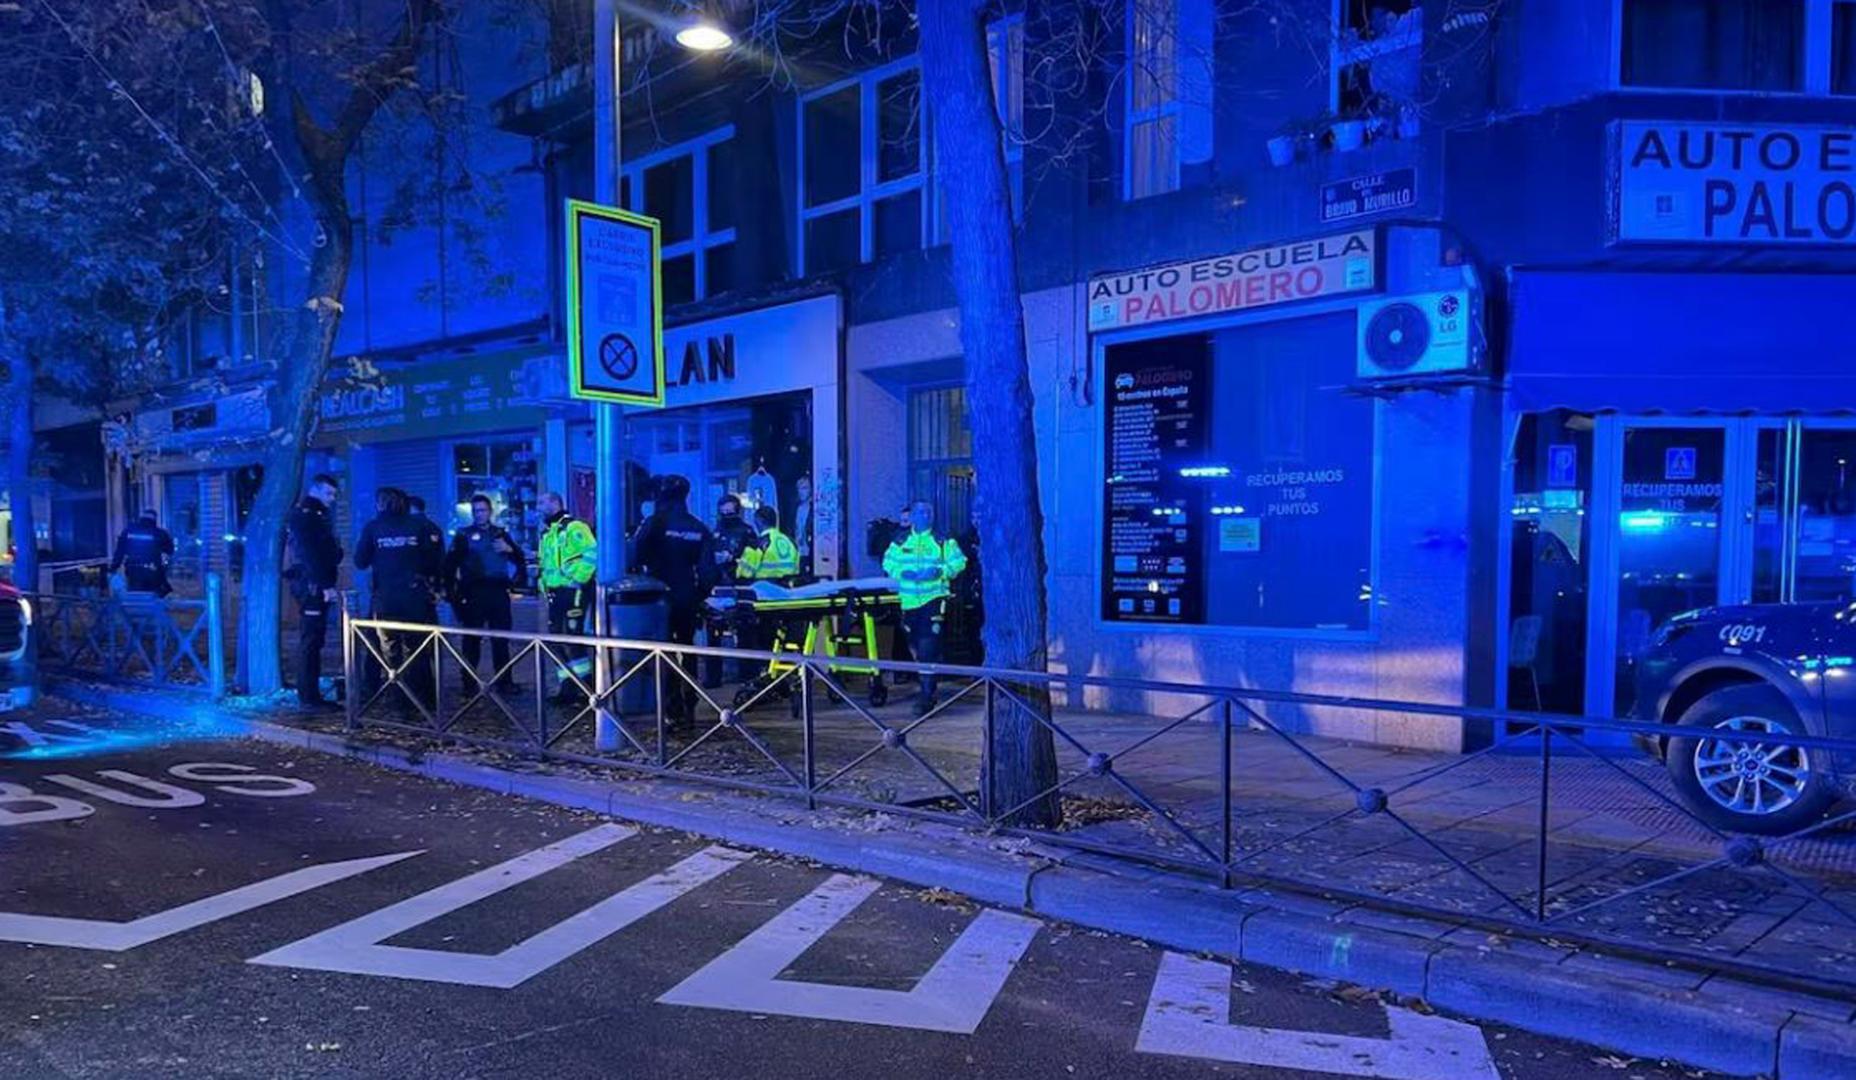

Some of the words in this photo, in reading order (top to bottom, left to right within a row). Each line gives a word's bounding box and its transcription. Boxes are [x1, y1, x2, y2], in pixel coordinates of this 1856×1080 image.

[1631, 129, 1801, 170] AUTO
[1704, 178, 1856, 239] PALO
[1092, 268, 1181, 300] AUTO
[1190, 235, 1368, 282] ESCUELA
[1124, 265, 1324, 323] PALOMERO
[1246, 469, 1343, 486] RECUPERAMOS
[1623, 483, 1722, 497] RECUPERAMOS
[1282, 487, 1307, 500] TUS
[1268, 502, 1319, 516] PUNTOS
